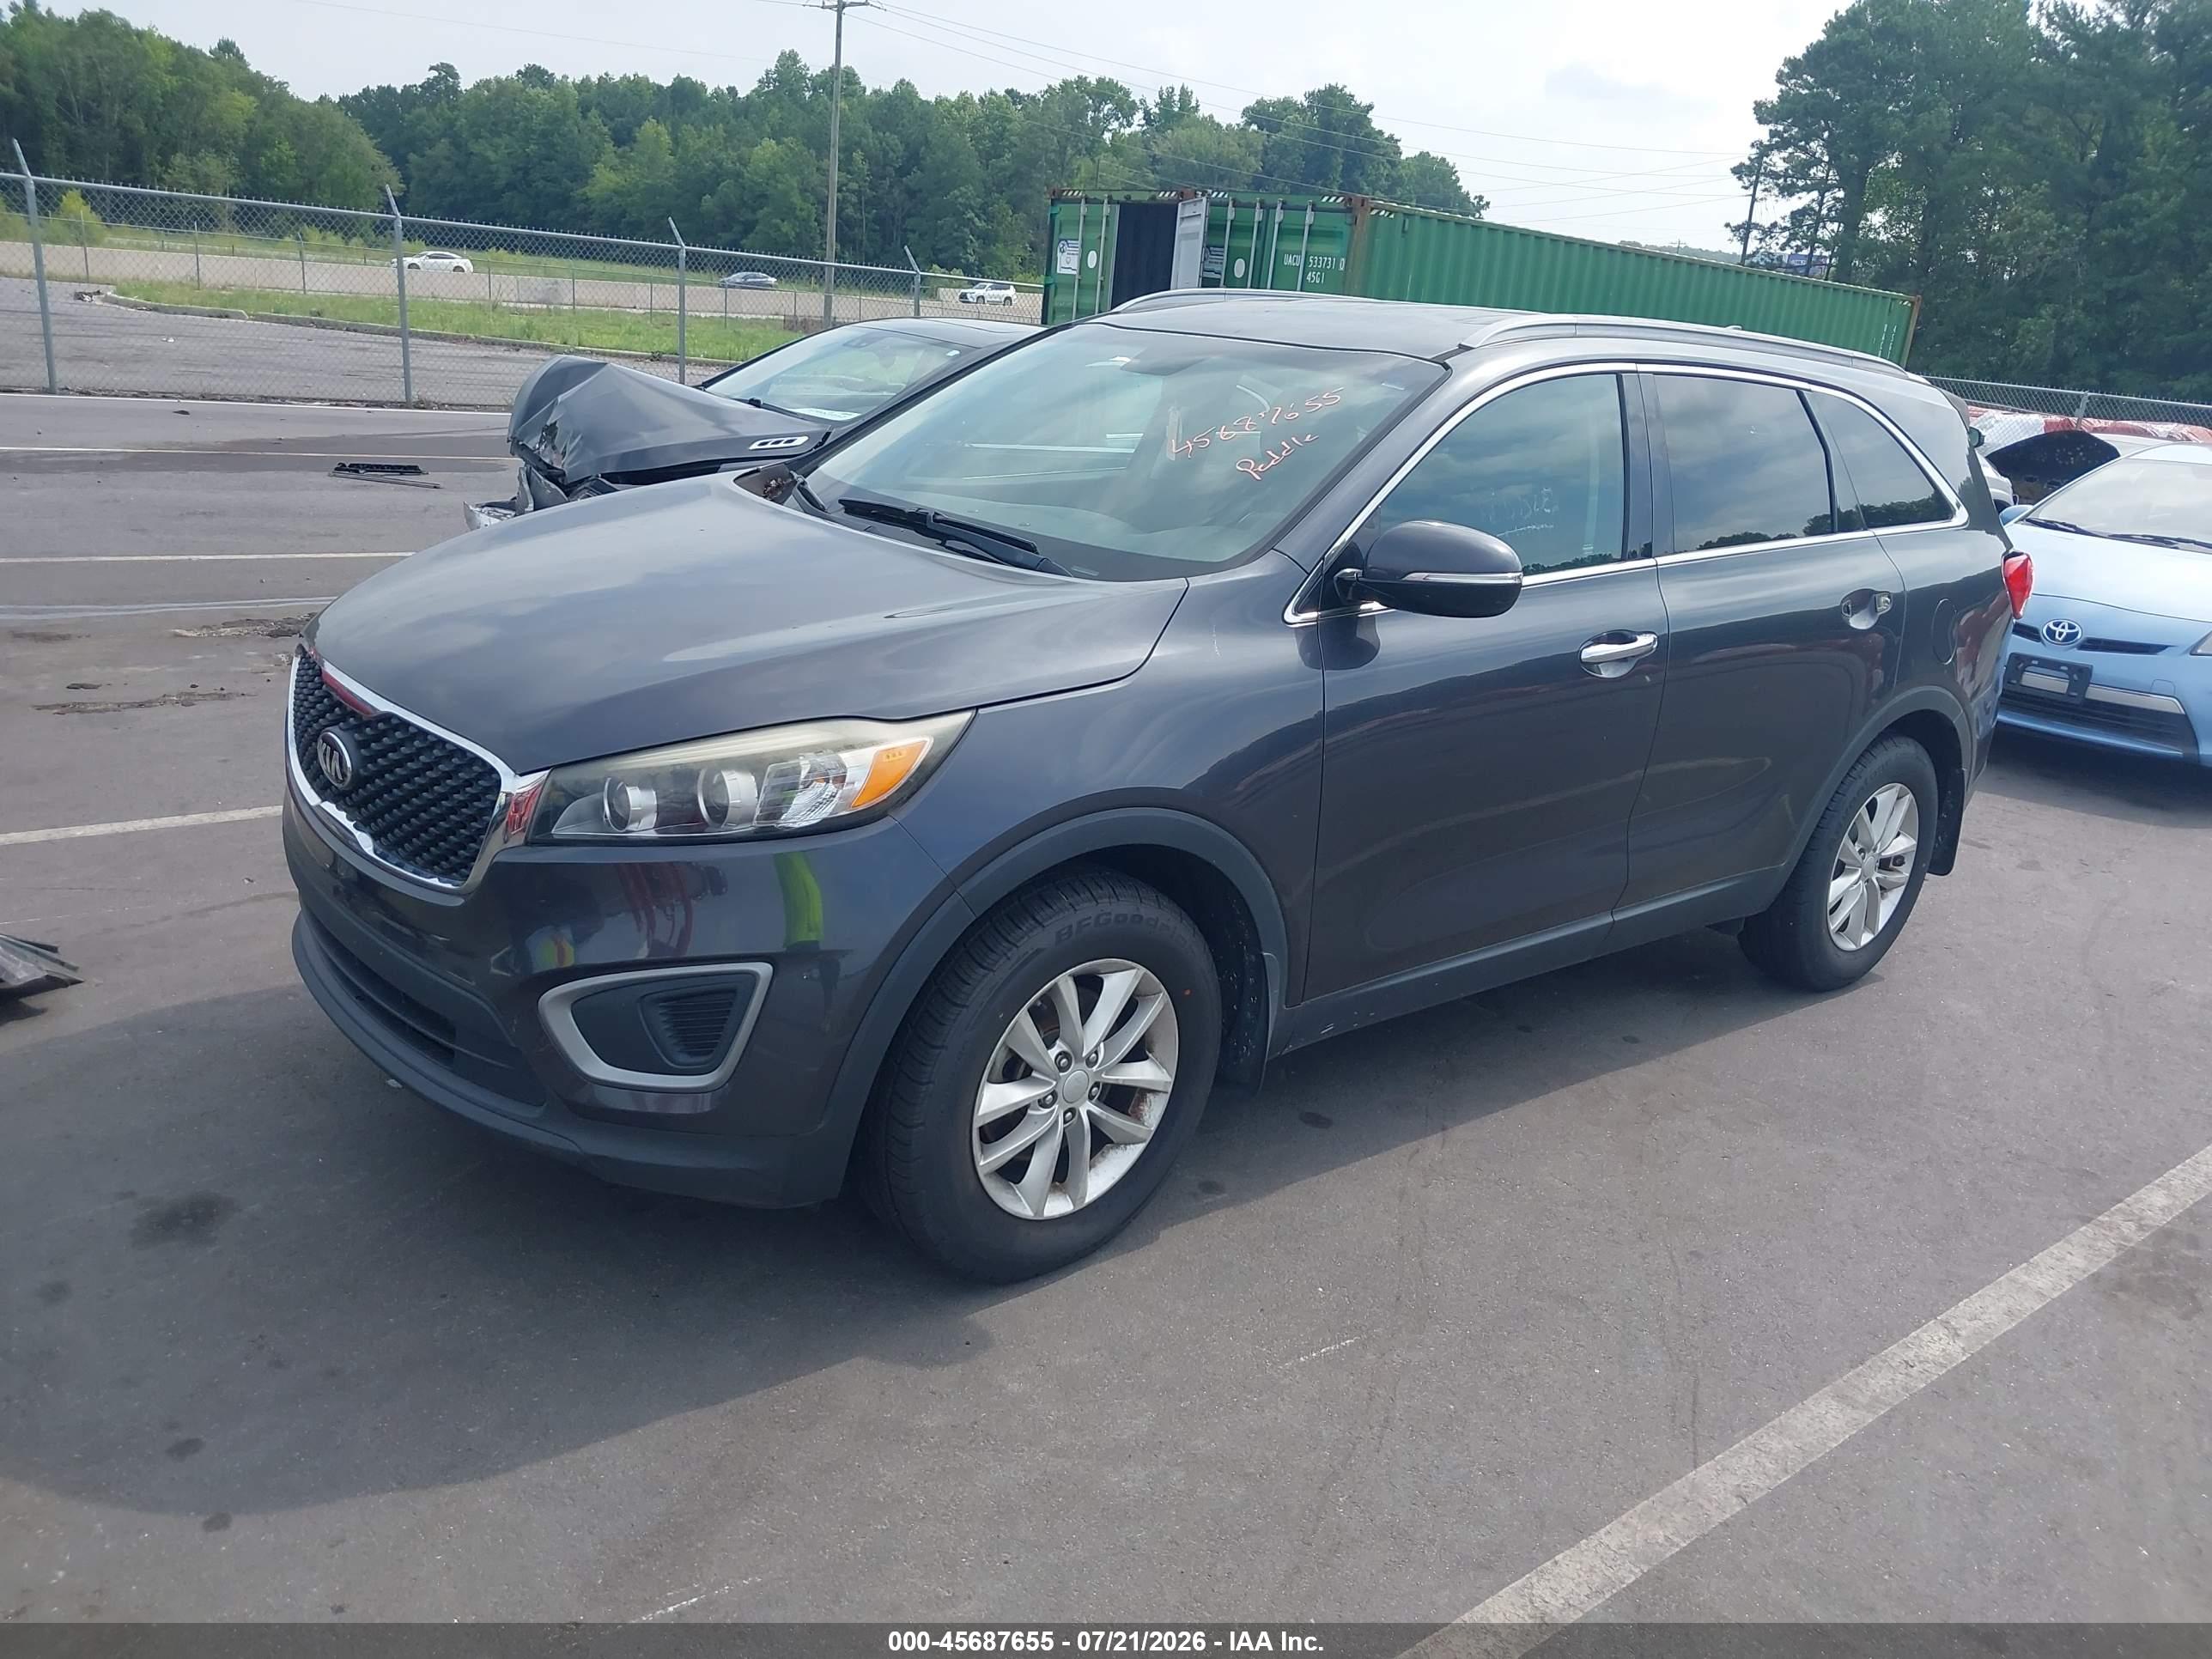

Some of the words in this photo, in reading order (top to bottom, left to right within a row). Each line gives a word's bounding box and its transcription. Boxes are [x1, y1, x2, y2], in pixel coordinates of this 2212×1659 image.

[1284, 253, 1301, 267] UACU
[1308, 255, 1336, 270] 533731
[1306, 271, 1325, 284] 45G1
[317, 738, 343, 781] KIA
